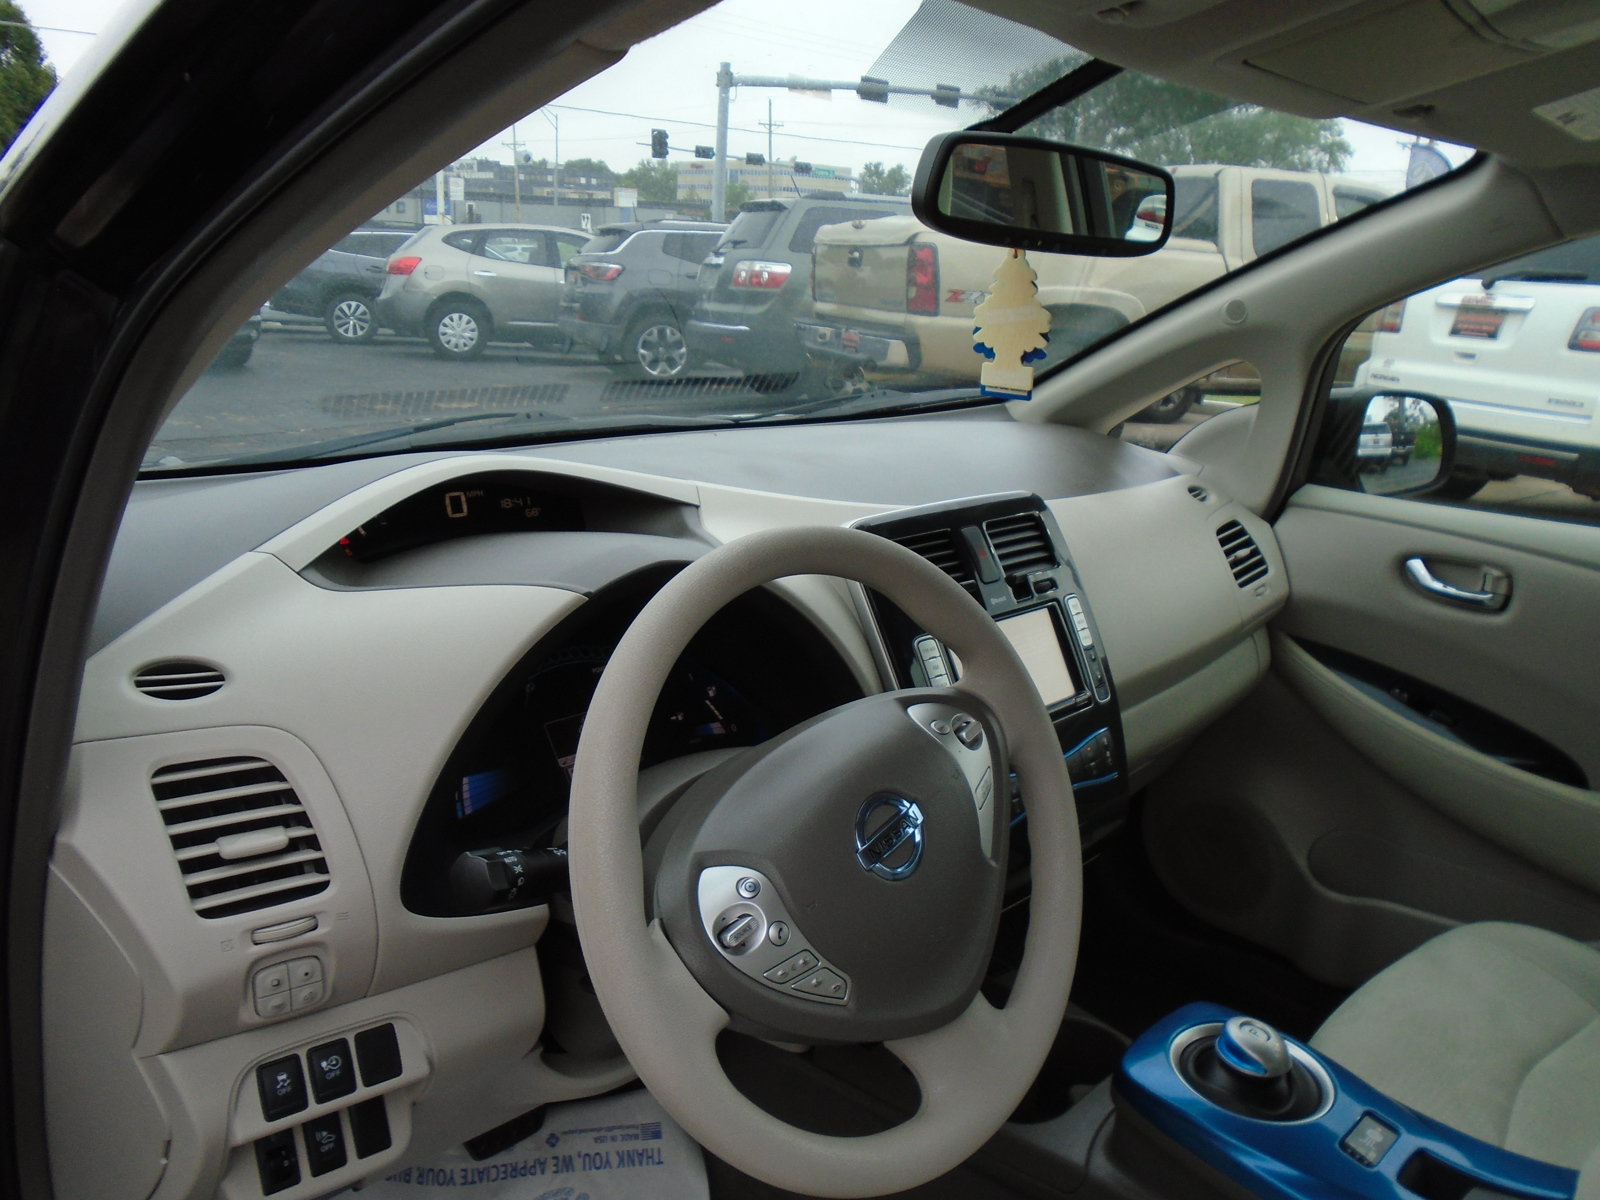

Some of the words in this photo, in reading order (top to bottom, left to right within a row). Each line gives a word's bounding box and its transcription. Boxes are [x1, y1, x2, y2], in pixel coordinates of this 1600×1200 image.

[867, 809, 920, 860] NISSAN
[552, 1155, 576, 1174] WE
[577, 1150, 612, 1171] YOU,
[617, 1147, 664, 1169] THANK
[416, 1167, 458, 1187] YOUR
[460, 1157, 548, 1186] APPRECIATE
